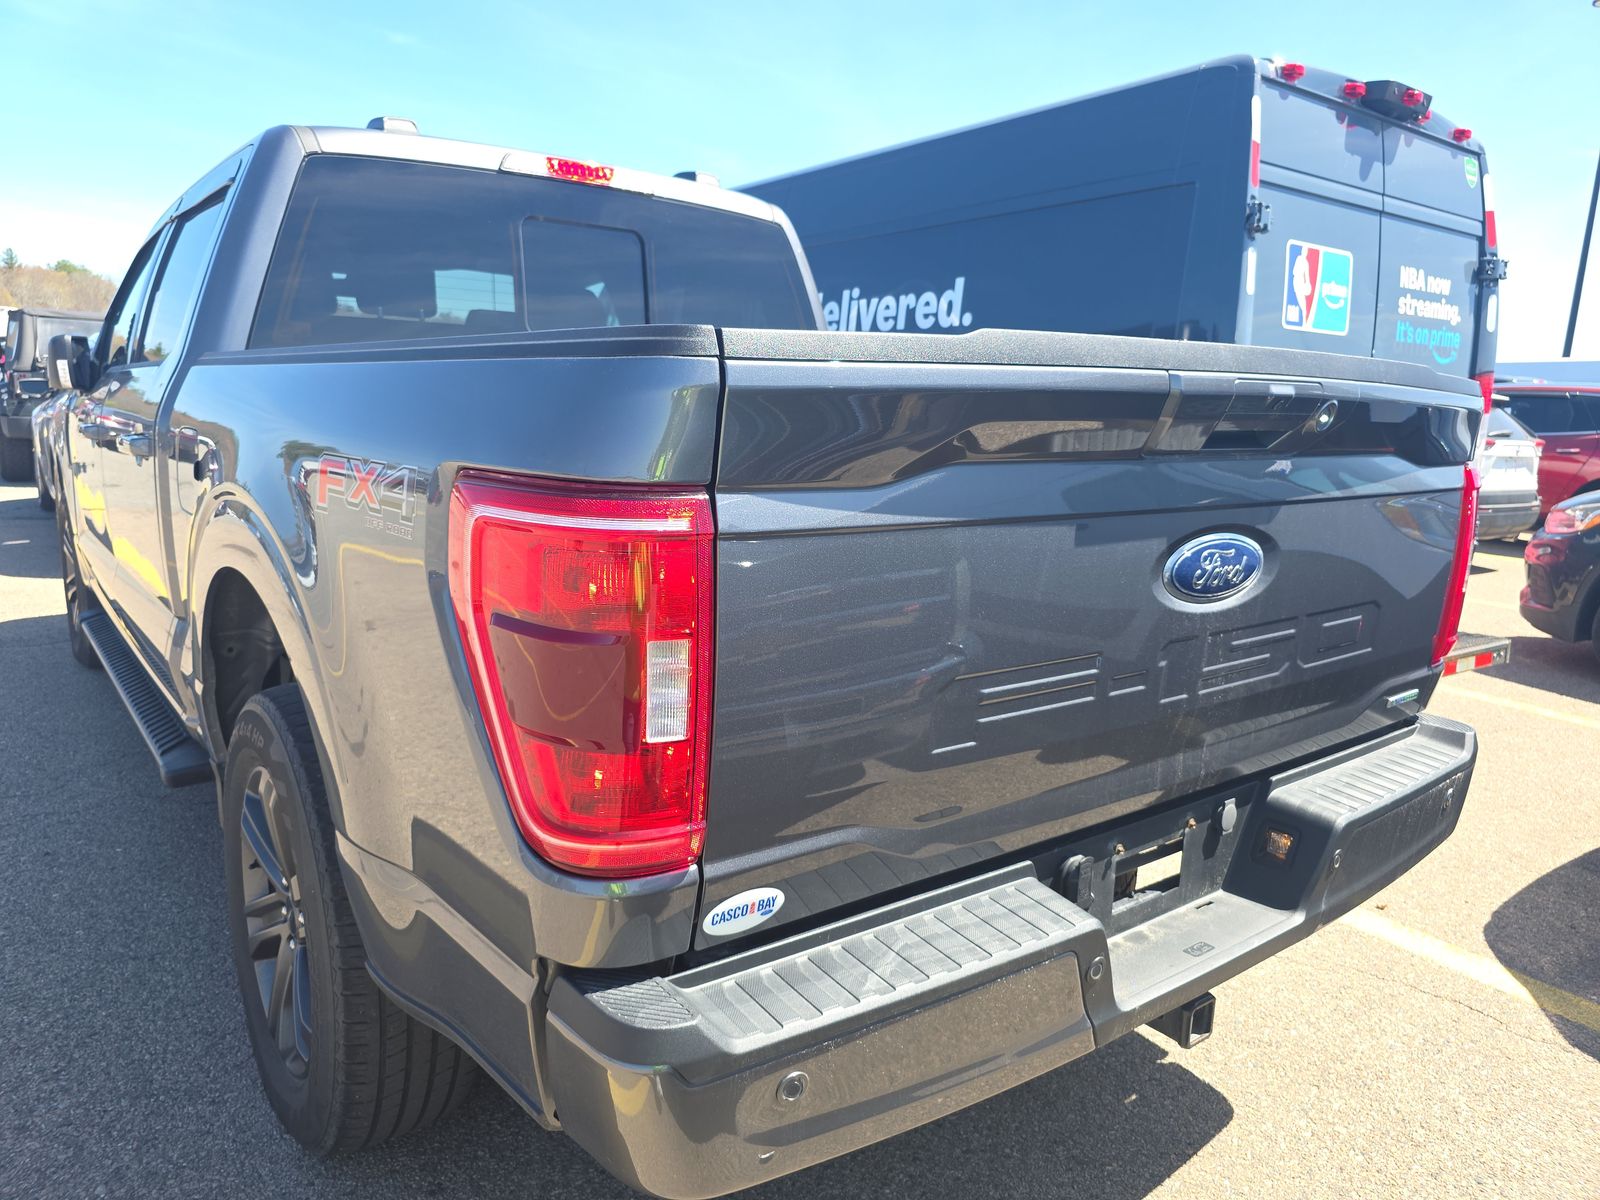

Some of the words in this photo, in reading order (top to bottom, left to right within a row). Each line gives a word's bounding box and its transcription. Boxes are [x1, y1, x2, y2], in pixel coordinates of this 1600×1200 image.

[1400, 265, 1425, 292] NBA
[1427, 275, 1451, 296] now
[818, 276, 973, 332] elivered.
[1398, 293, 1461, 326] streaming.
[1396, 320, 1414, 343] It's
[1415, 327, 1429, 345] on
[1430, 327, 1462, 352] prime
[315, 452, 418, 526] FX4
[1192, 548, 1248, 590] Ford
[711, 903, 749, 926] CASCO
[757, 895, 778, 912] BAY
